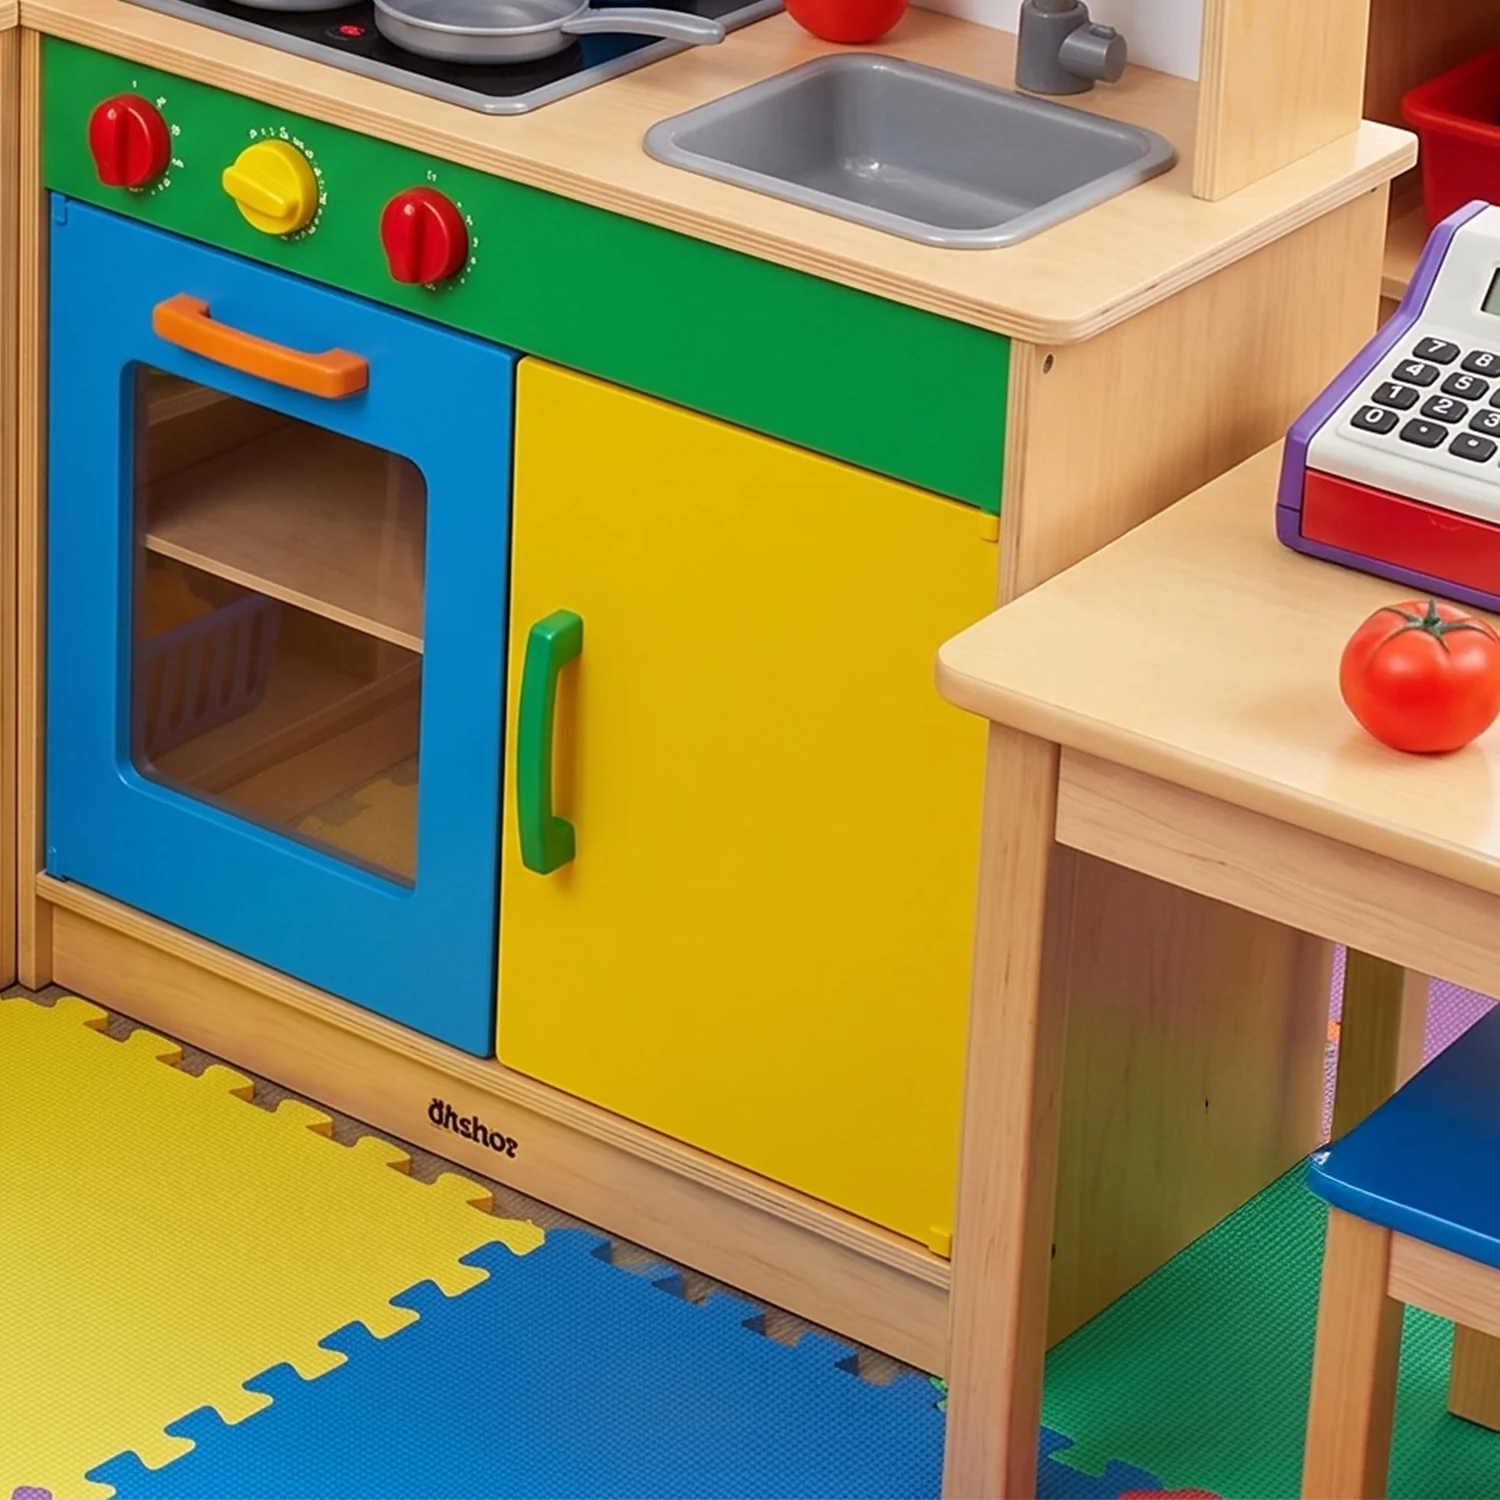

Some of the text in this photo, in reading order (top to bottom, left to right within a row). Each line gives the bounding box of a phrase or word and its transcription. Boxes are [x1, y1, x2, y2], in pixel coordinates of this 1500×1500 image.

[1428, 340, 1494, 367] 7 8
[1405, 364, 1425, 376] 4
[1365, 409, 1384, 423] 0
[1389, 386, 1500, 427] 1 2 3
